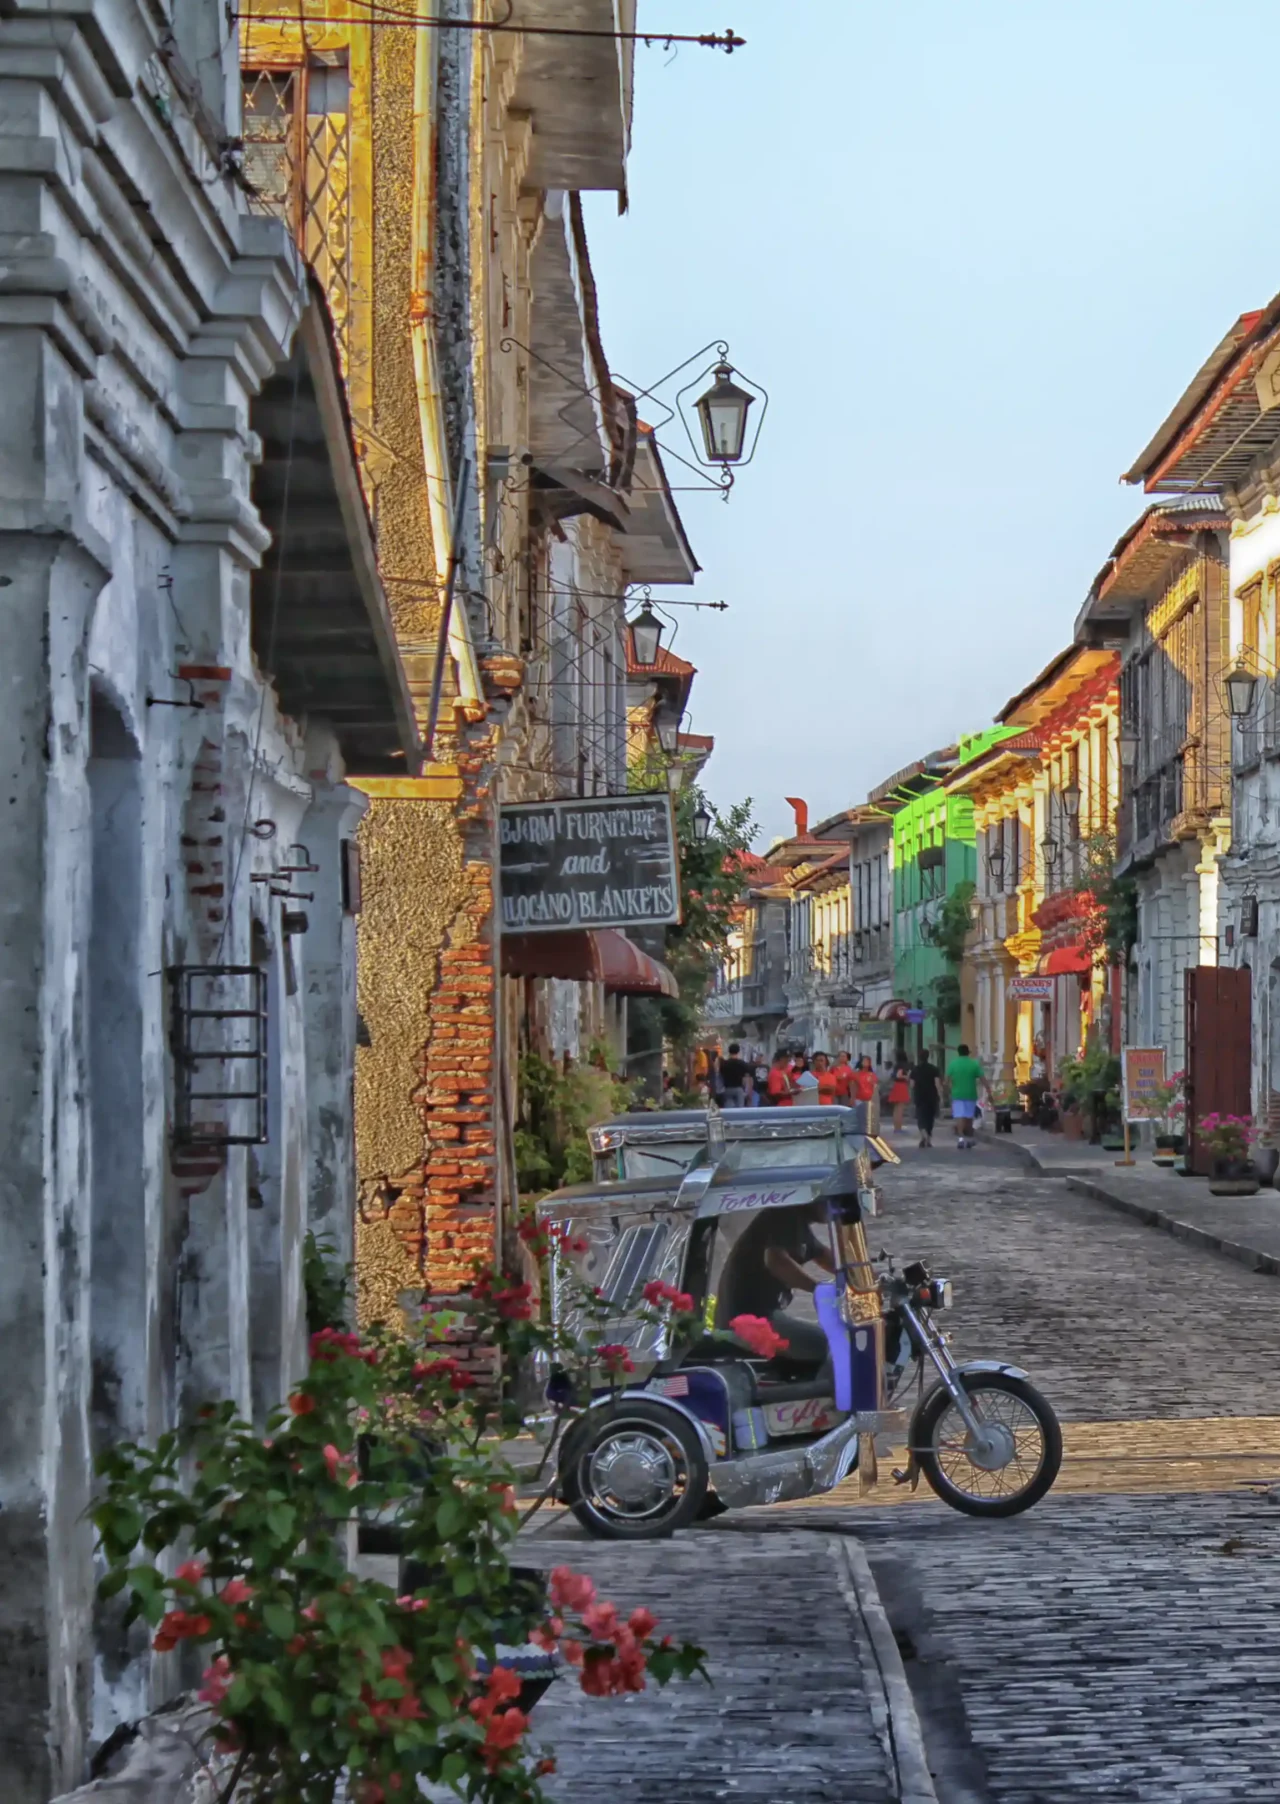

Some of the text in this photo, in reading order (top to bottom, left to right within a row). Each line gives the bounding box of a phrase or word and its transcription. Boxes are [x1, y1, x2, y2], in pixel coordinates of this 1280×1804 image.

[566, 807, 658, 843] FURNITURE
[560, 846, 611, 876] and
[503, 883, 674, 924] ILOCANO BLANKETS
[718, 1189, 797, 1210] Forever
